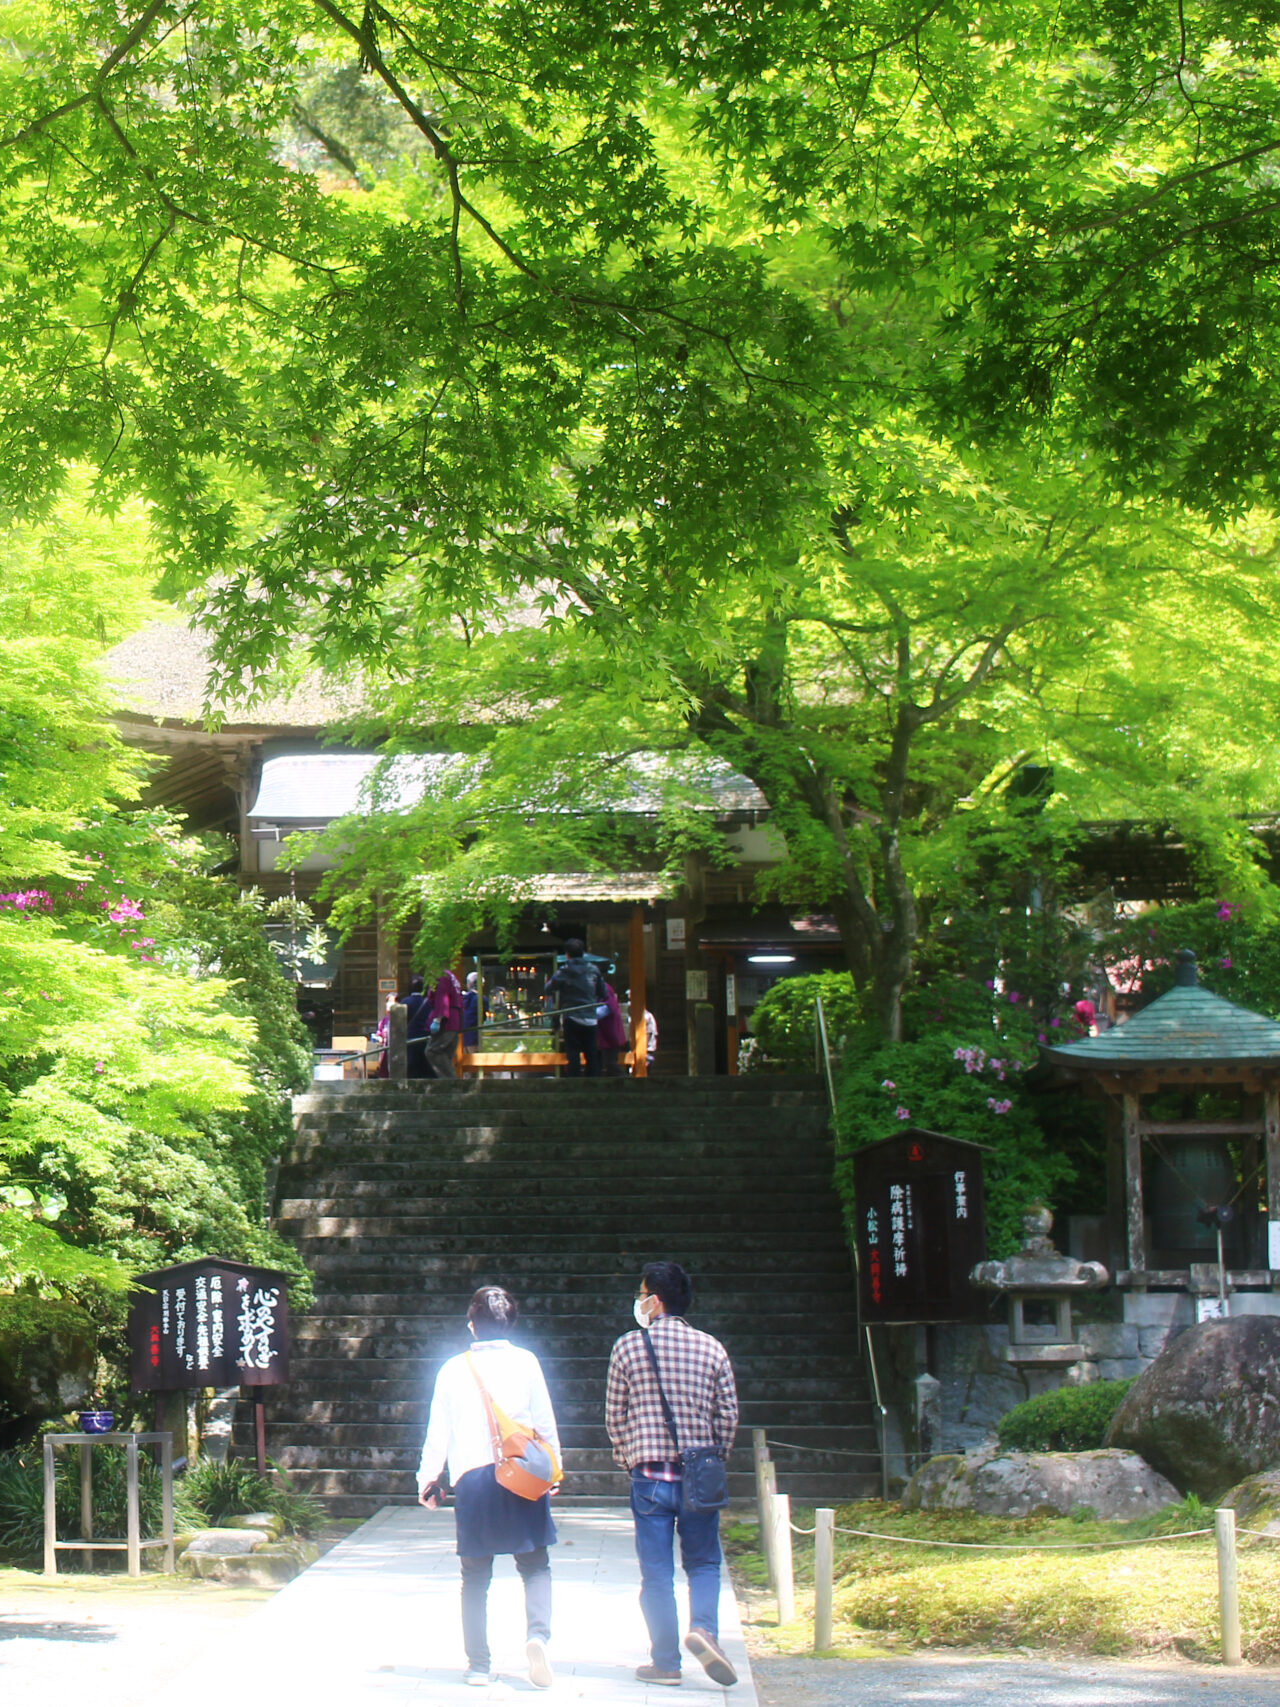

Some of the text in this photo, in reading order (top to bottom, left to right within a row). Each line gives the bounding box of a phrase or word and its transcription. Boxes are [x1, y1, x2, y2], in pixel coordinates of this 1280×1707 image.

[954, 1171, 967, 1218] 行事案内
[866, 1207, 879, 1245] 小松山
[175, 1288, 187, 1358] 受付ております
[236, 1293, 255, 1368] を求めて
[253, 1288, 280, 1369] 心のやすらぎ
[185, 1354, 196, 1370] など
